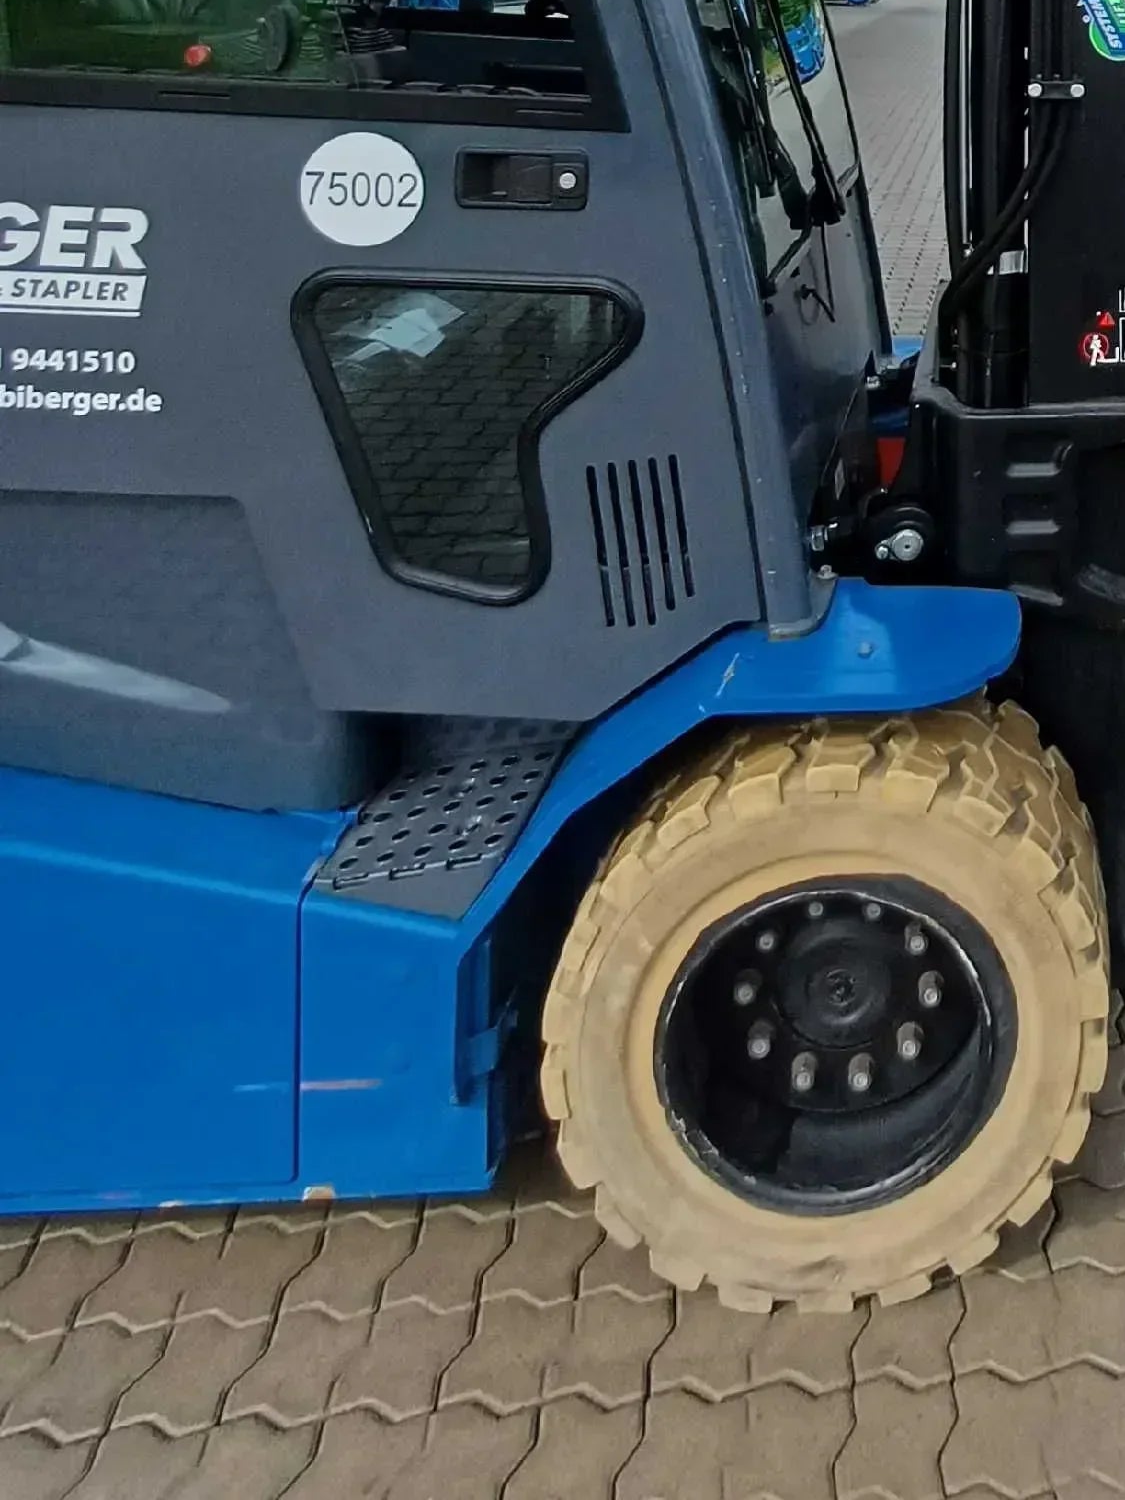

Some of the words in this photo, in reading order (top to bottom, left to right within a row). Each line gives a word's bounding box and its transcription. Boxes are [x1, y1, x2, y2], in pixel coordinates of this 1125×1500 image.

[305, 171, 418, 207] 75002
[0, 202, 149, 269] GER
[11, 278, 129, 301] STAPLER
[12, 347, 136, 373] 9441510
[0, 383, 163, 416] biberger.de
